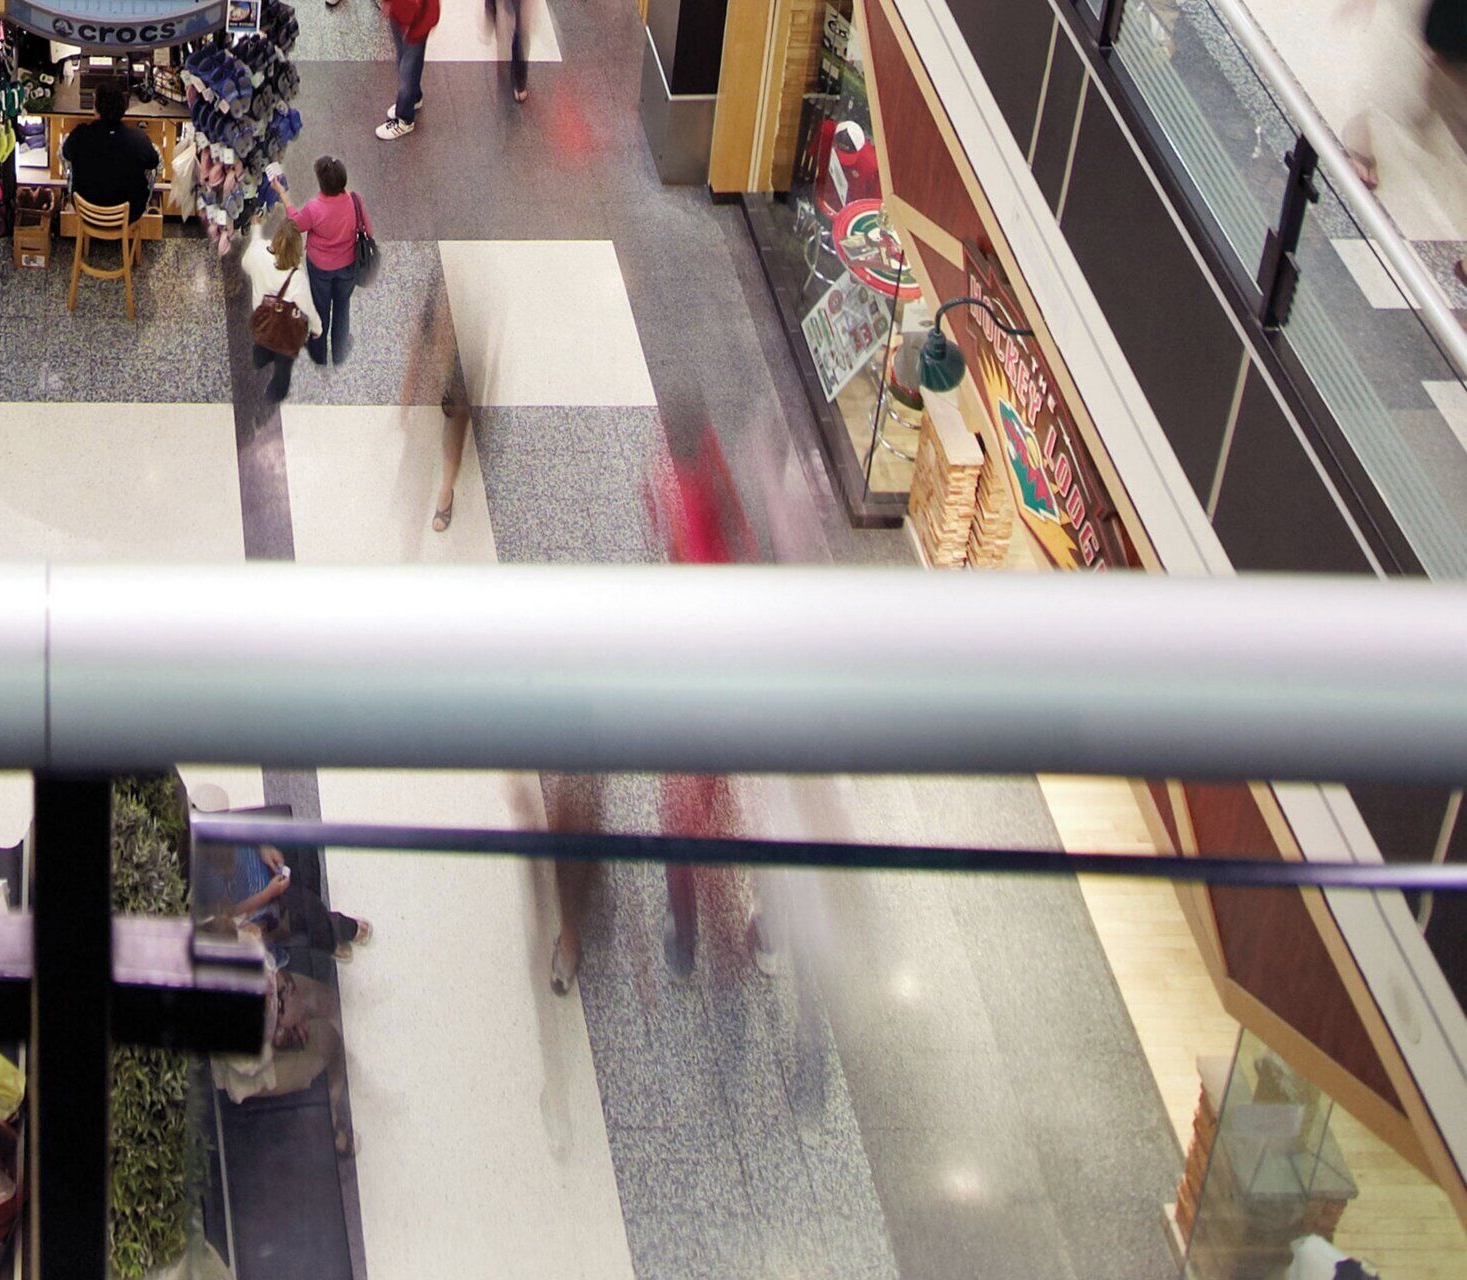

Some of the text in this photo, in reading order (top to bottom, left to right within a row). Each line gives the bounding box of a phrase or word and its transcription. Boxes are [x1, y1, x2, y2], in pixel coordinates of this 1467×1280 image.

[78, 21, 176, 43] crocs
[1031, 355, 1057, 413] THE
[969, 273, 1106, 569] HOCKEY LODG
